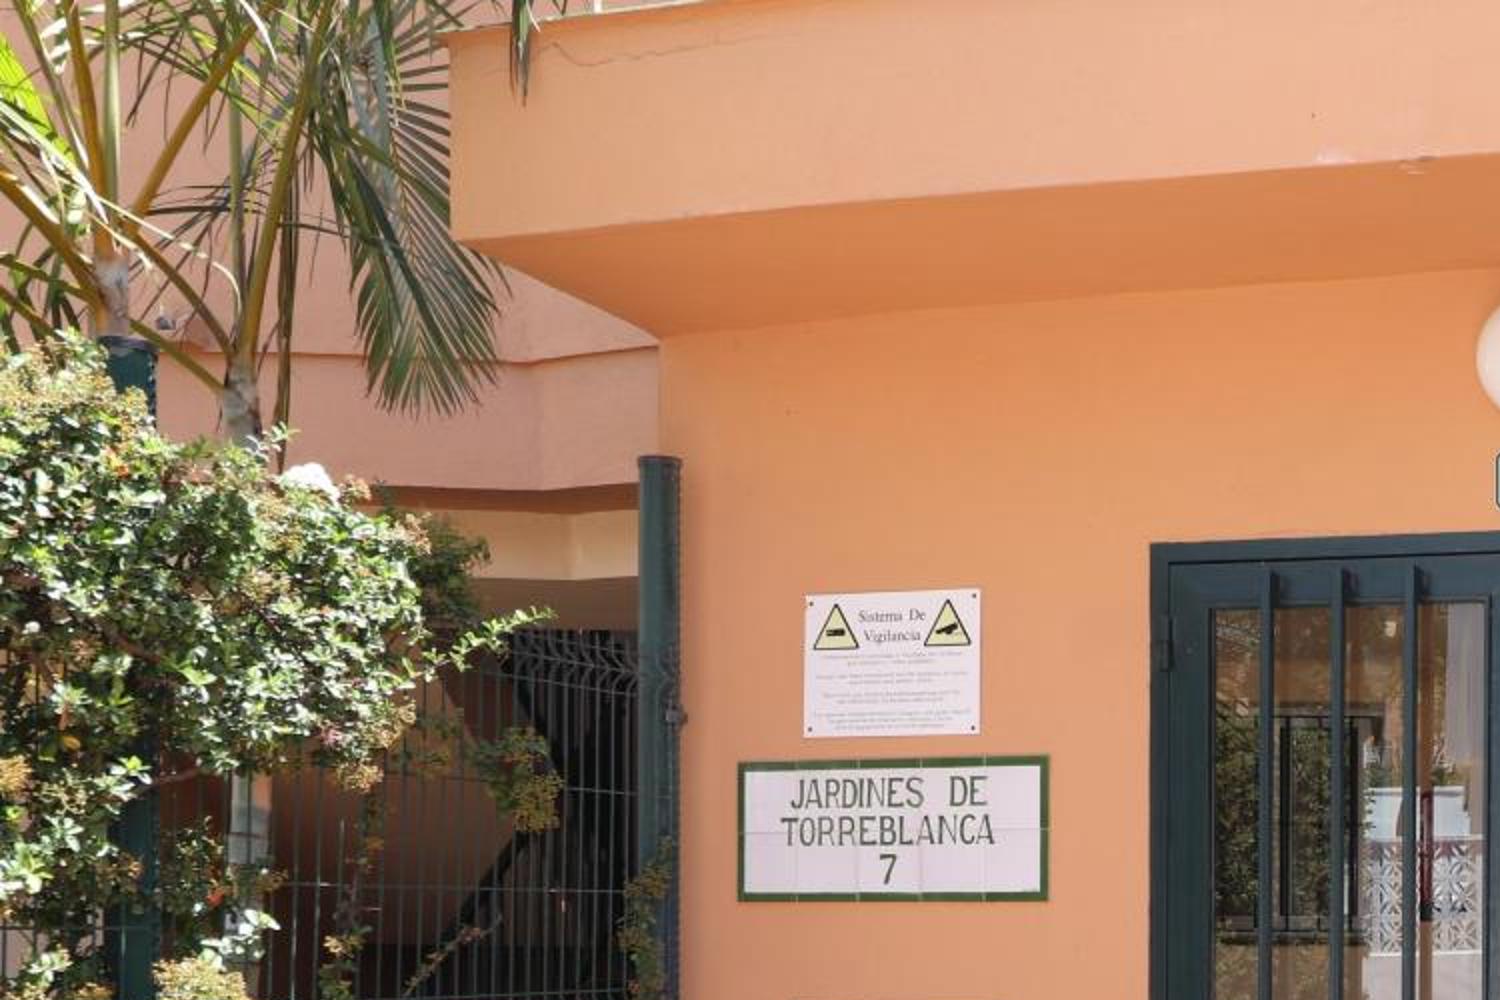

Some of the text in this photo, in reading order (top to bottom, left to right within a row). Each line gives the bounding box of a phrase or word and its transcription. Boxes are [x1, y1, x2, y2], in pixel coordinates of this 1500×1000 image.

[858, 608, 927, 622] Sistema De
[863, 629, 922, 646] Vigilancia
[790, 775, 988, 809] JARDINES DE
[780, 814, 995, 847] TORREBLANCA
[878, 853, 898, 885] 7
